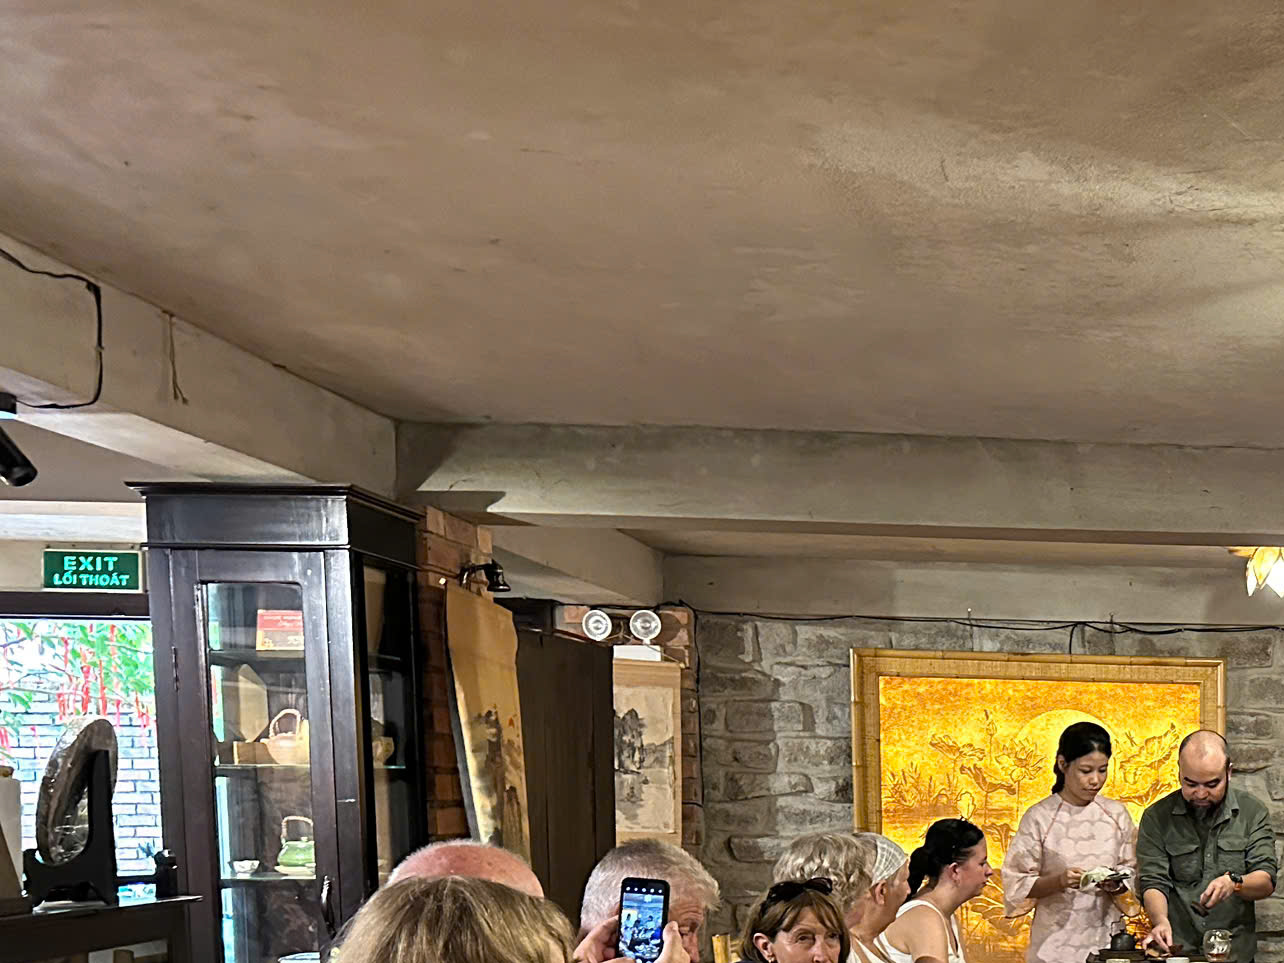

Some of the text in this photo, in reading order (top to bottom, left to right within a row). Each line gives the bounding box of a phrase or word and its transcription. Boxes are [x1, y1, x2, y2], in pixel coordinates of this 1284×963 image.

[63, 556, 118, 571] EXIT
[53, 570, 130, 586] LỐI THOÁT
